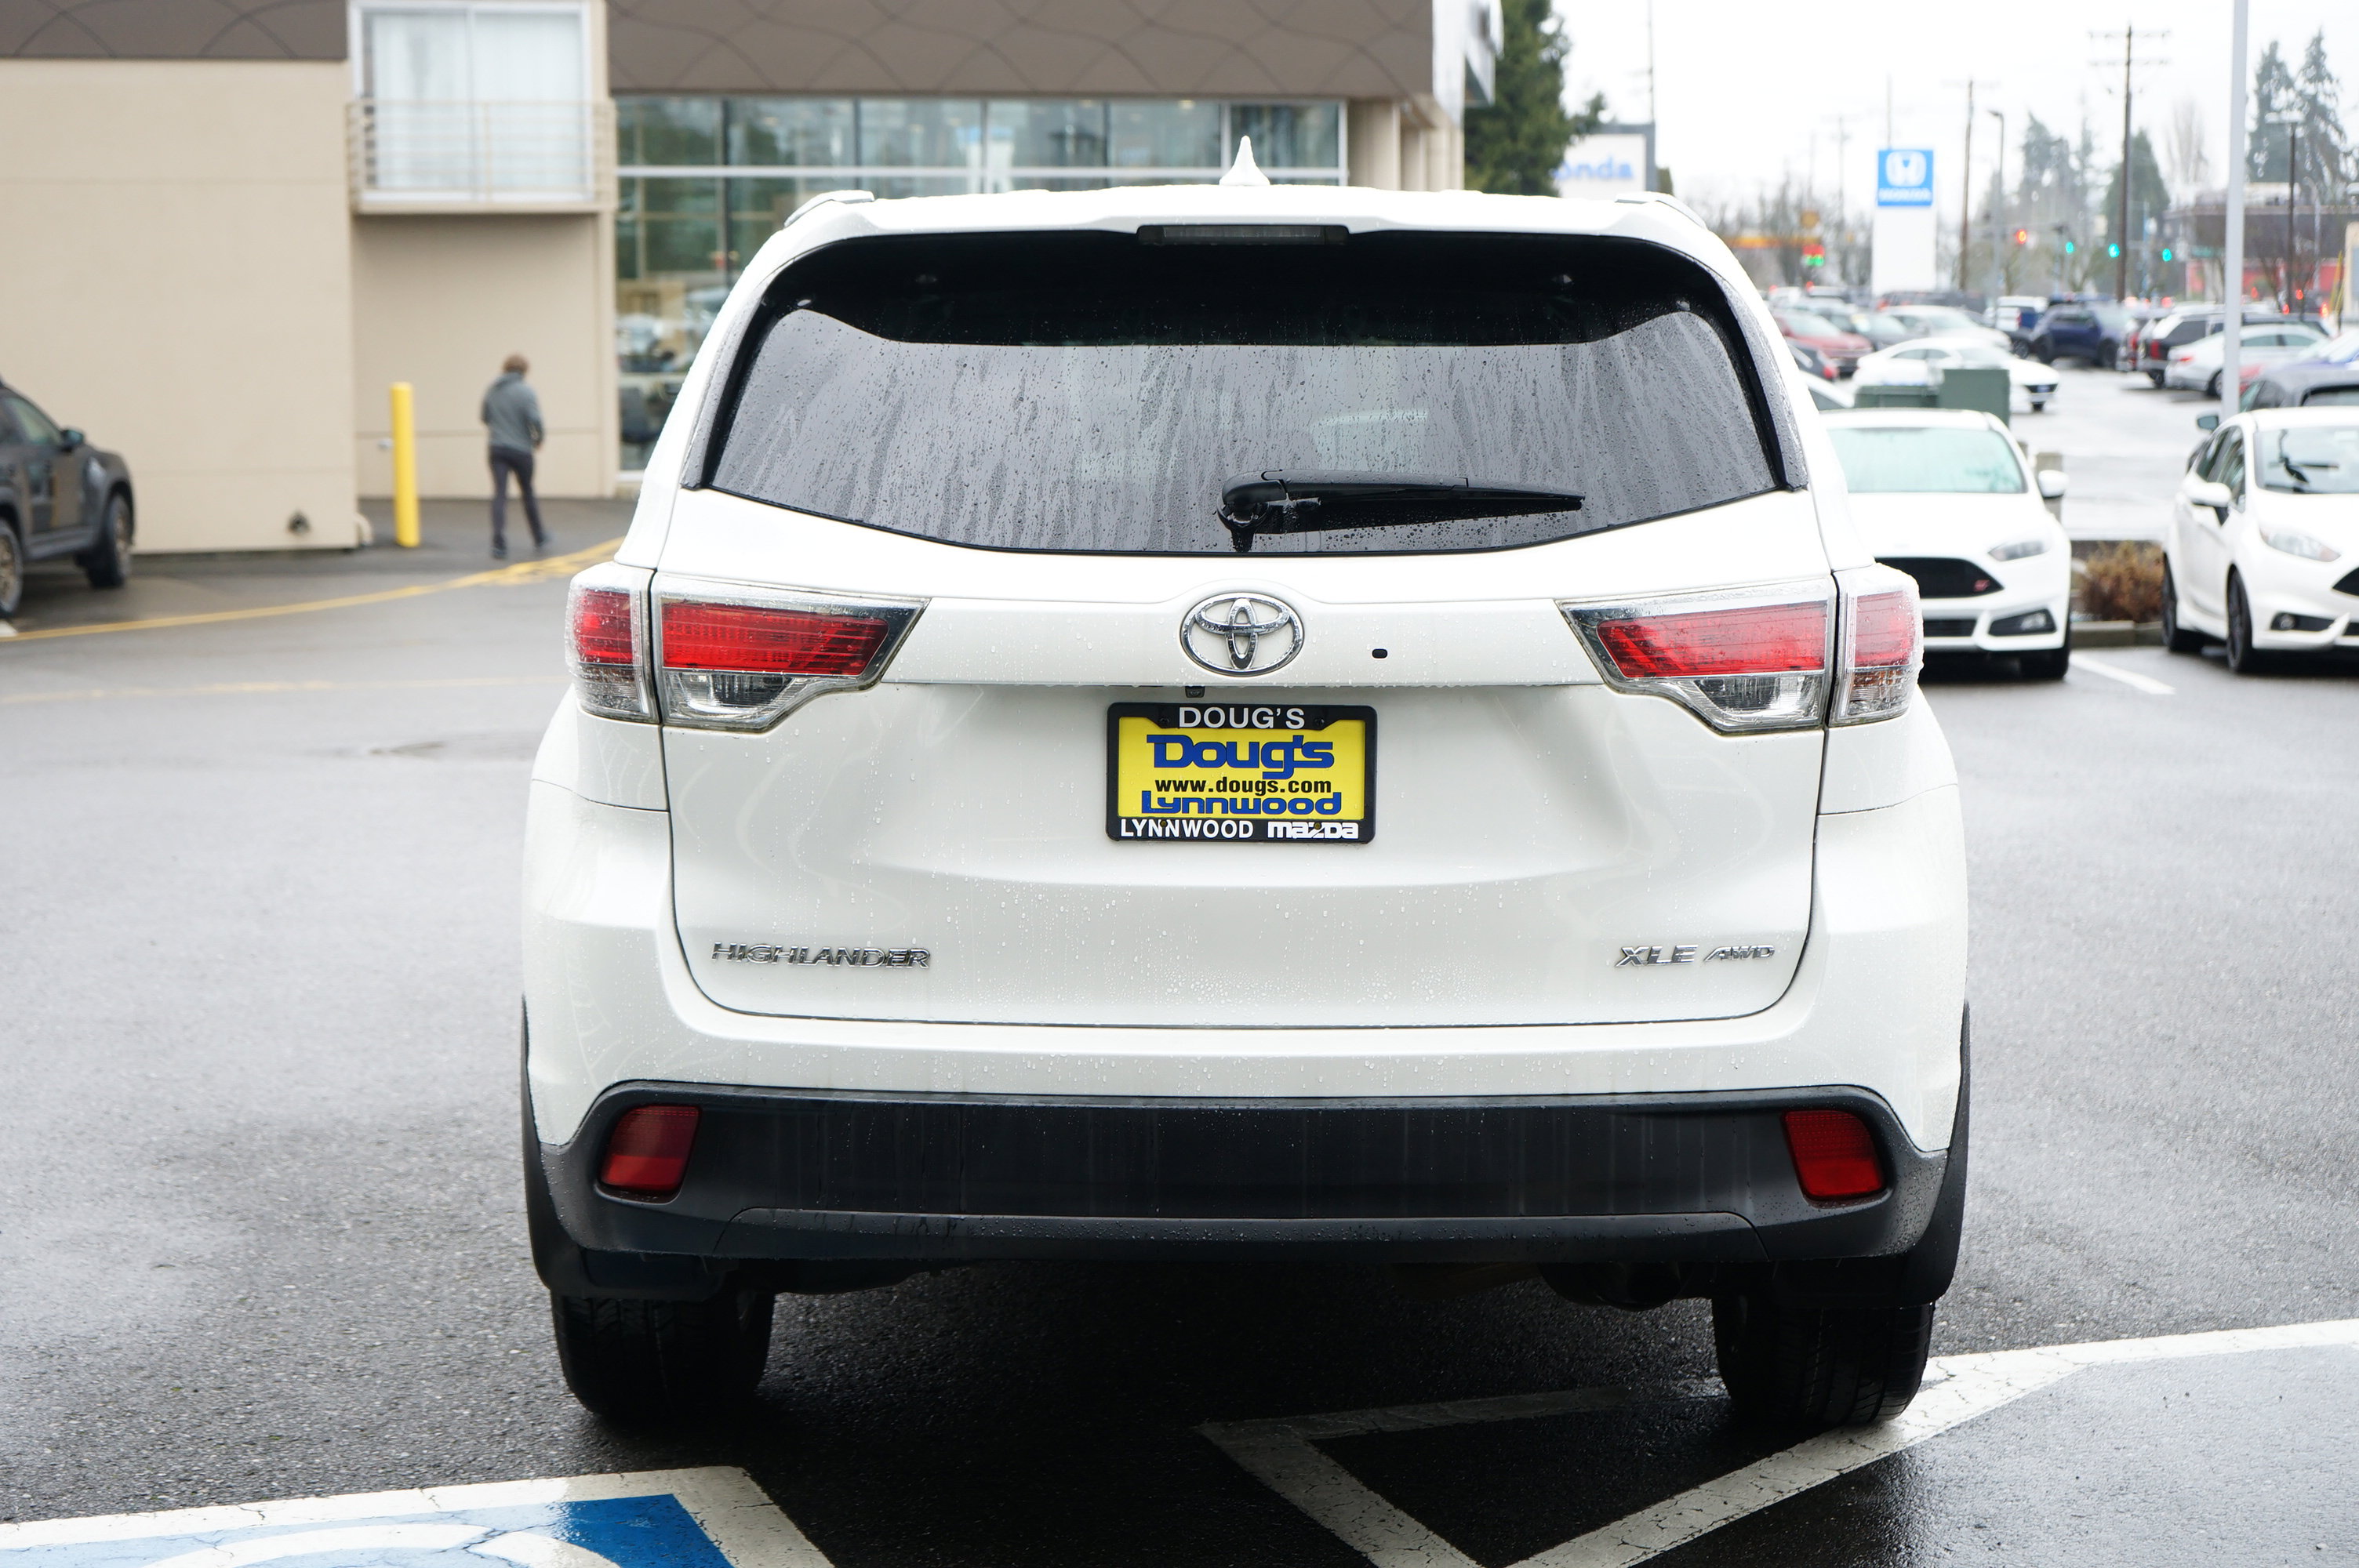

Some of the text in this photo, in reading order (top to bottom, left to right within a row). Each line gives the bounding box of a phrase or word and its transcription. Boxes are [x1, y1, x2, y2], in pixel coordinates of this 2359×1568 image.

[1553, 155, 1633, 180] onda
[1179, 707, 1305, 728] DOUG'S
[1147, 735, 1335, 779] Doug's
[1155, 776, 1331, 796] www.dougs.com
[1142, 791, 1342, 815] Lynnwood
[1121, 819, 1253, 837] LYNNWOOD
[711, 942, 931, 969] HIGHLANDER
[1615, 944, 1776, 967] XLE AWD
